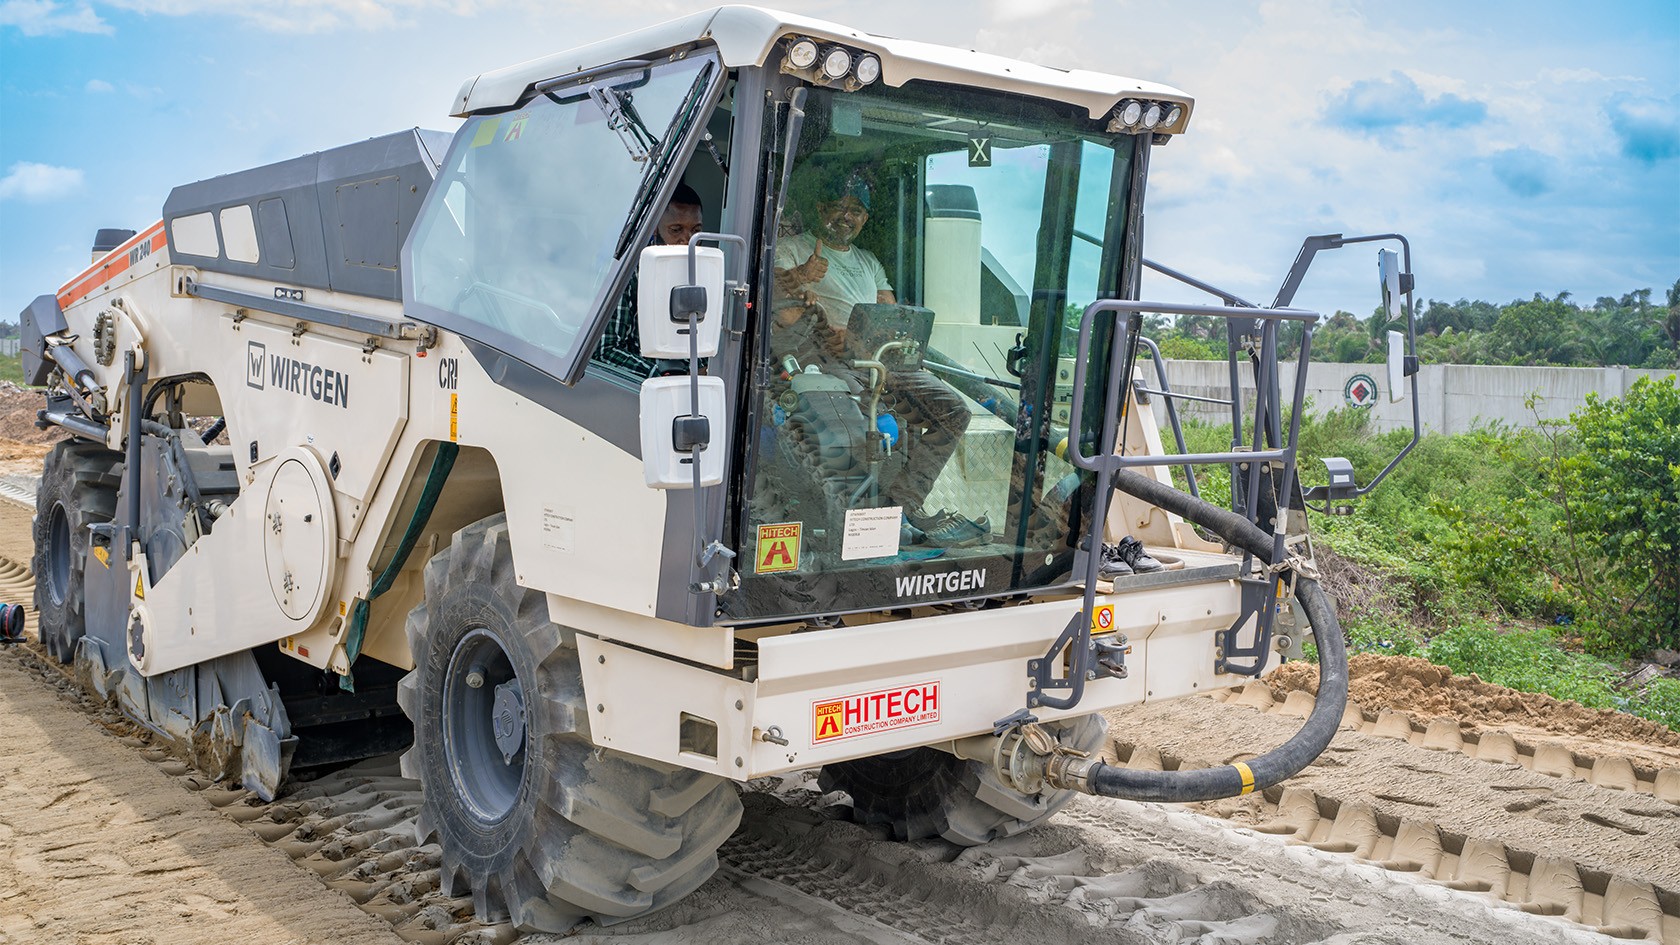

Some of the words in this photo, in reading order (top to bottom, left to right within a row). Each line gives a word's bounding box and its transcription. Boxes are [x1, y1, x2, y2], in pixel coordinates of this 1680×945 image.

[970, 138, 989, 162] X
[270, 353, 349, 409] WIRTGEN
[761, 527, 798, 538] HITECH
[895, 568, 986, 598] WIRTGEN
[817, 704, 842, 716] HITECH
[845, 685, 938, 726] HITECH
[844, 721, 889, 735] CONSTRUCTION
[889, 717, 916, 726] COMPANY
[916, 711, 938, 722] LIMITED
